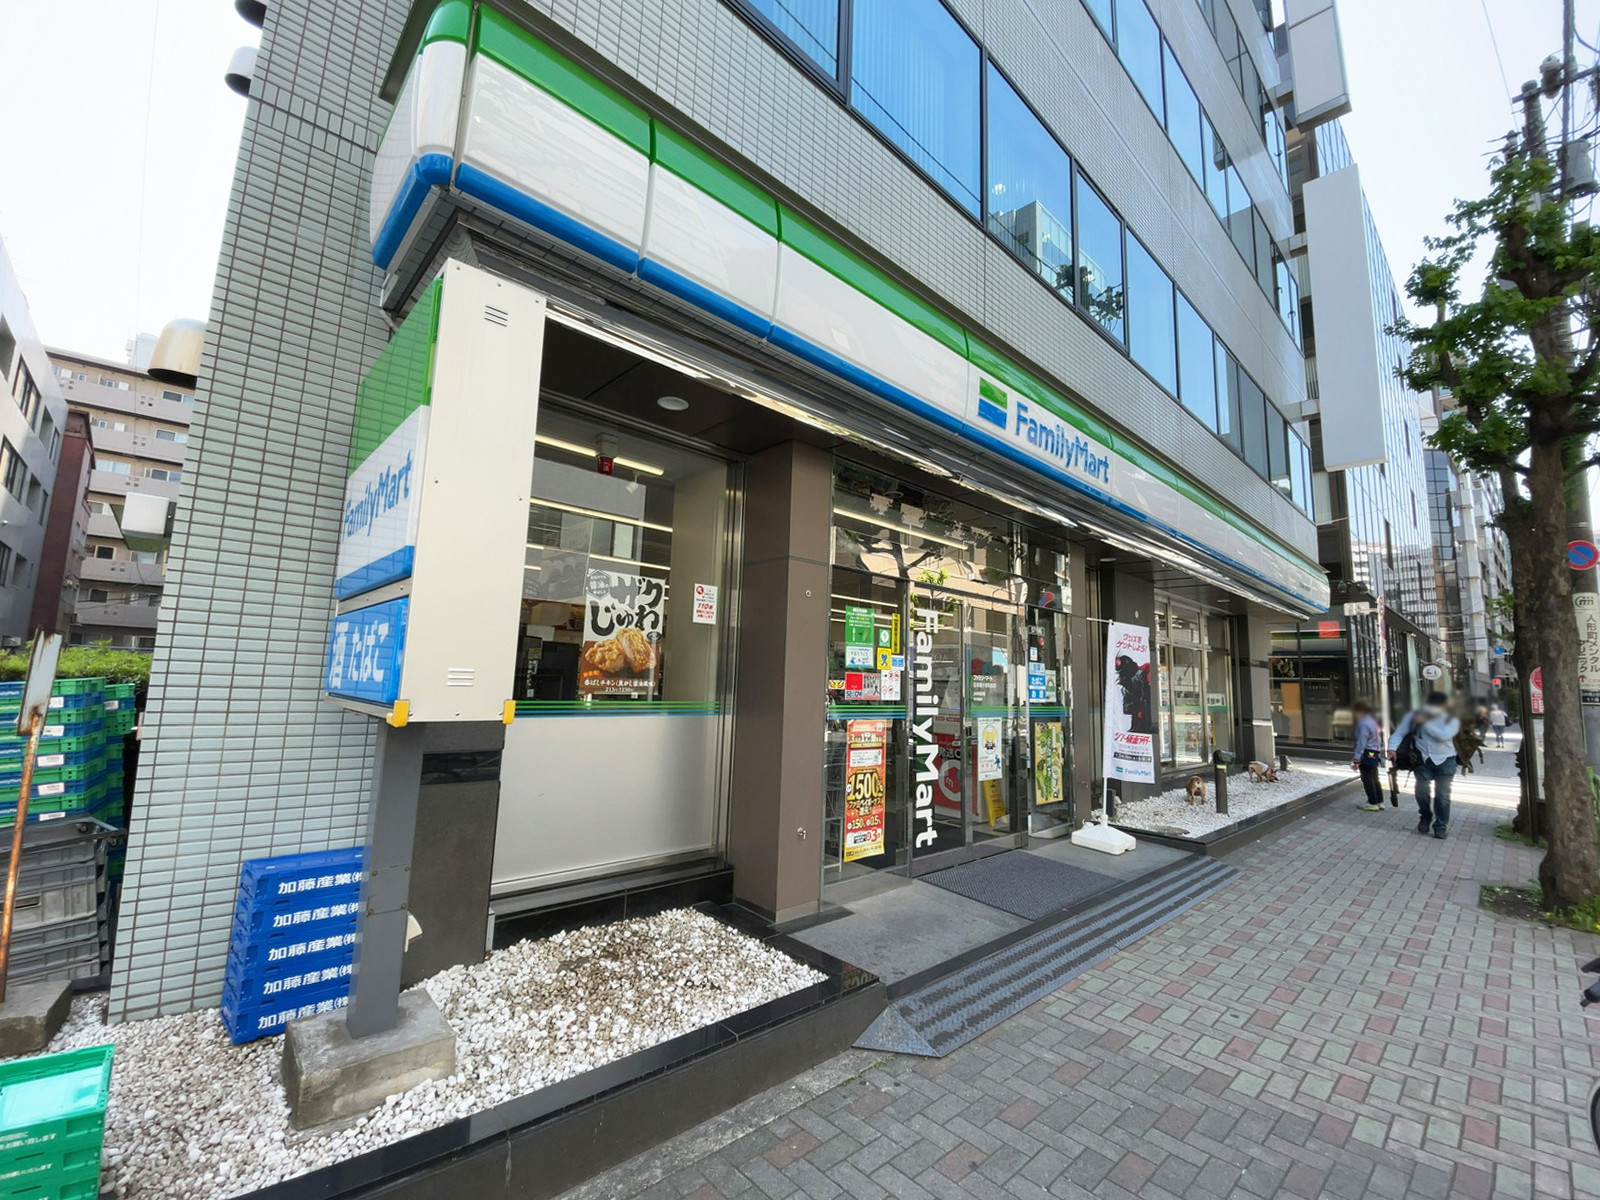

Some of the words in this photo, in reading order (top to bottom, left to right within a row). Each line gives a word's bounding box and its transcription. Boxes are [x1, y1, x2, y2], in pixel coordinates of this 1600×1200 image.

[1015, 401, 1110, 483] FamilyMart
[341, 451, 412, 542] FamilyMart
[329, 621, 349, 689] 酒
[348, 619, 389, 683] たばこ
[1585, 614, 1600, 673] 人形町メンタル
[912, 608, 940, 849] FamilyMart
